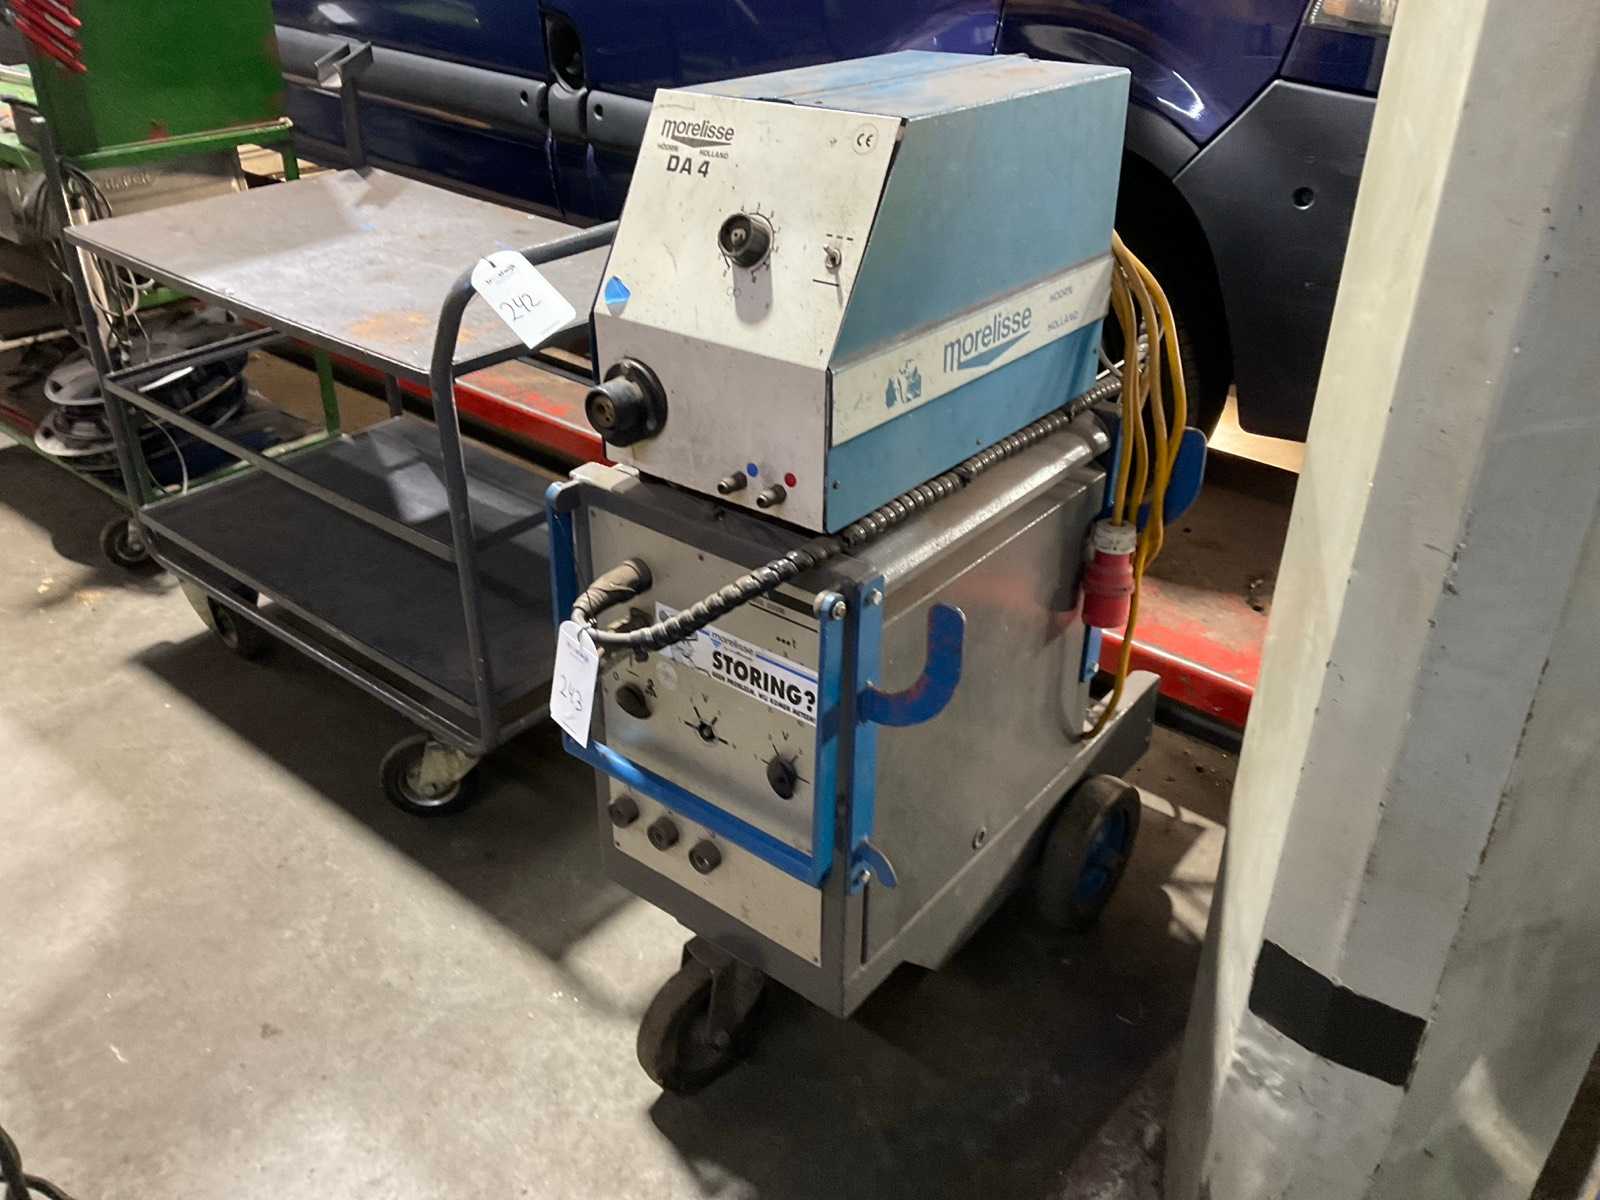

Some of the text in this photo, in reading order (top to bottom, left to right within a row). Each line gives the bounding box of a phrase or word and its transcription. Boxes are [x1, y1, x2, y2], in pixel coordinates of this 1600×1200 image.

[661, 119, 735, 141] morelisse
[856, 132, 874, 148] CE
[666, 154, 711, 178] DA 4
[499, 293, 542, 321] 242
[943, 307, 1032, 374] morelisse
[560, 674, 583, 712] 243
[712, 649, 816, 713] STORING?
